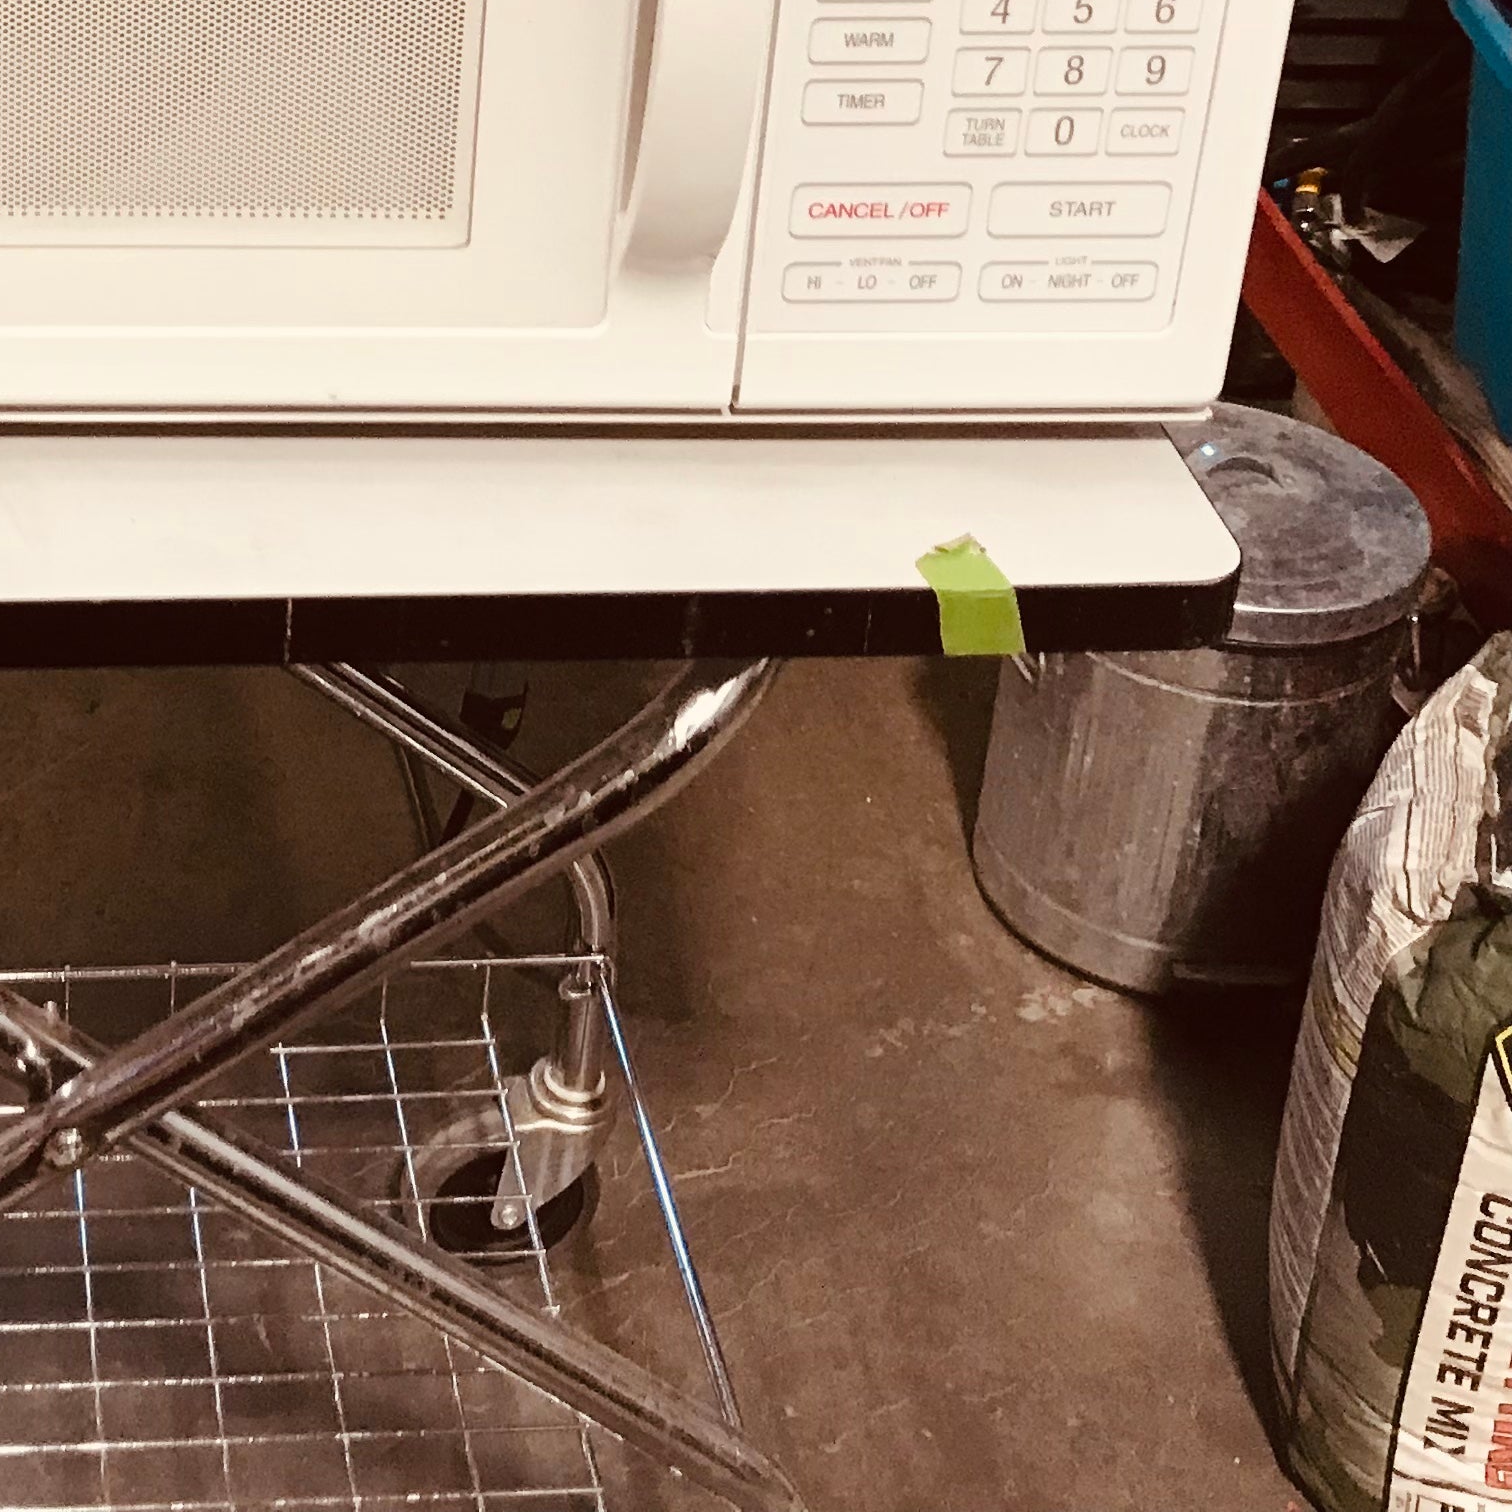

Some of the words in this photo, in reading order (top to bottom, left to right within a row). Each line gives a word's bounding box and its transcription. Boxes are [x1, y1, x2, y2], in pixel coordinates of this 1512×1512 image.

[844, 32, 894, 48] WARM
[984, 56, 1004, 86] 7
[1063, 55, 1085, 85] 8
[1145, 55, 1166, 85] 9
[837, 93, 885, 109] TIMER
[965, 118, 1006, 131] TURN
[1054, 115, 1075, 146] 0
[1120, 124, 1170, 138] CLOCK
[962, 132, 1004, 146] TABLE
[1048, 201, 1116, 217] START
[1054, 256, 1088, 265] LIGHT
[857, 275, 877, 289] LO
[909, 274, 938, 289] OFF
[1001, 274, 1023, 289] ON
[1047, 274, 1091, 288] NIGHT
[1111, 273, 1139, 288] OFF
[1436, 1192, 1512, 1392] CONCRETE
